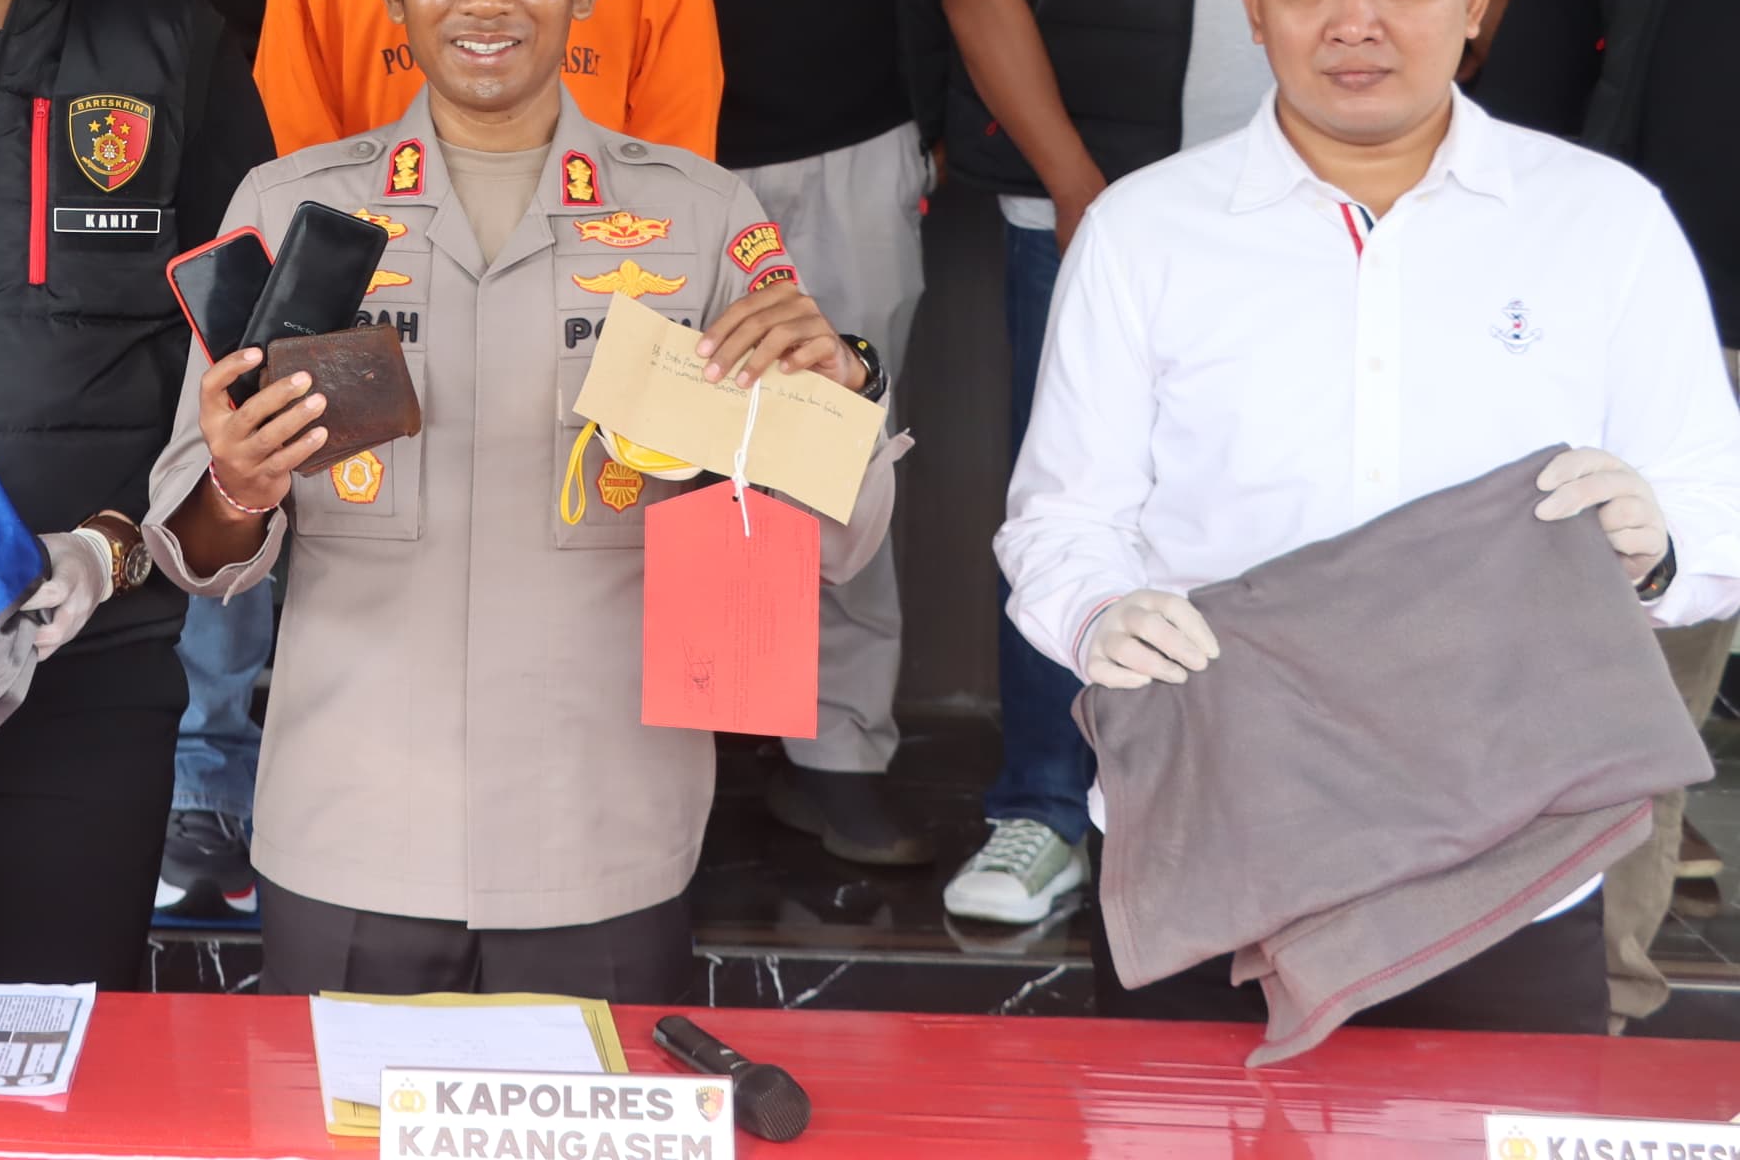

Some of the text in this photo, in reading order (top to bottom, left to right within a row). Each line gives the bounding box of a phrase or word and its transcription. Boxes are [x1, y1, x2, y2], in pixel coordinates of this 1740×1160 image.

[76, 98, 145, 114] BARESKRIM
[85, 213, 139, 229] KANIT
[435, 1080, 675, 1121] KAPOLRES
[398, 1125, 712, 1160] KARANGASEM
